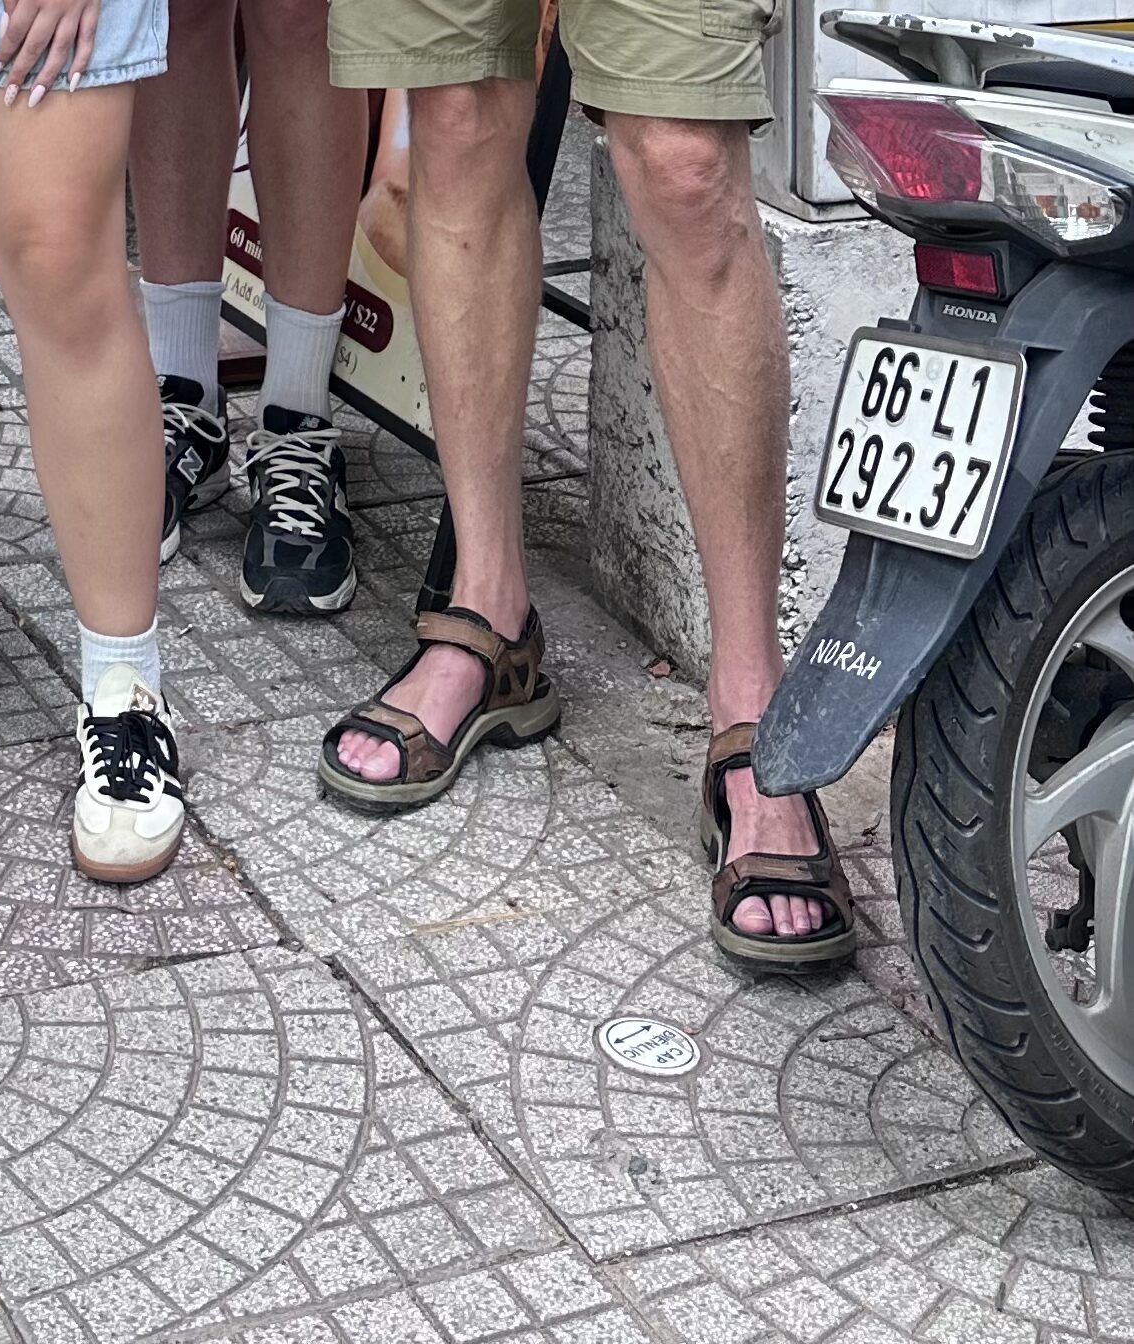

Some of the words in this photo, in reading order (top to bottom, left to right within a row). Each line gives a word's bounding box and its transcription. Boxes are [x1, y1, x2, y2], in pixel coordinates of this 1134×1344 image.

[230, 227, 245, 248] 60
[942, 304, 997, 323] HONDA
[861, 346, 991, 446] 66-L1
[825, 428, 991, 537] 292.37
[810, 639, 882, 680] NORAH
